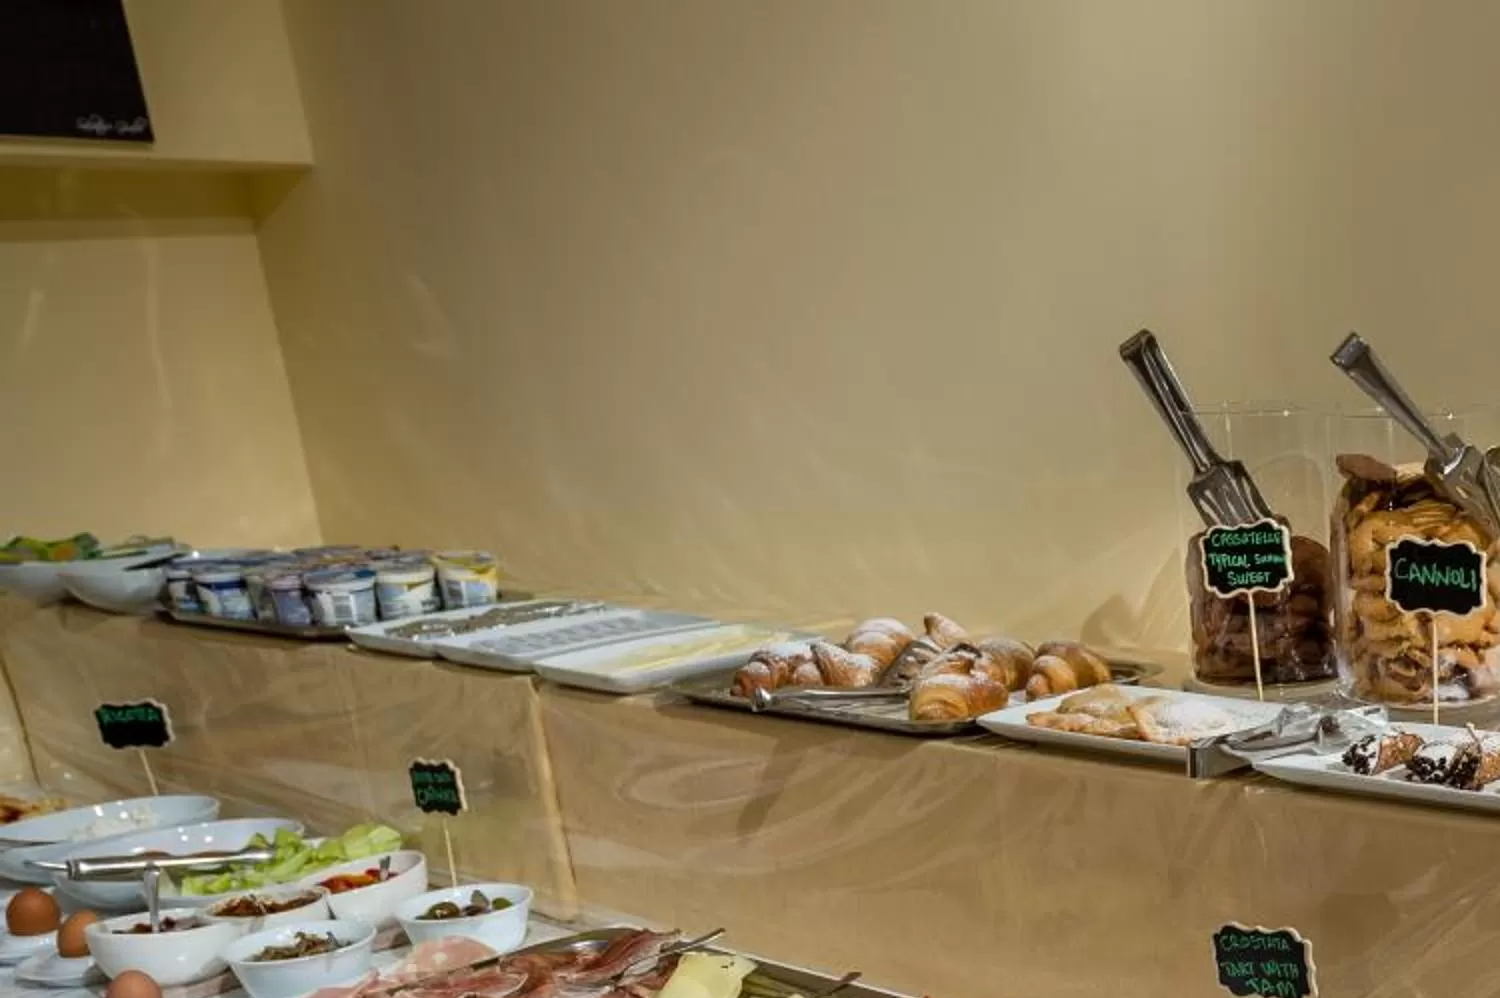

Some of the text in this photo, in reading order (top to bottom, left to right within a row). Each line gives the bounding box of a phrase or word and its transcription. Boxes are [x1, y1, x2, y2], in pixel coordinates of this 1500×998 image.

[1208, 552, 1252, 572] TYPICAL
[1227, 570, 1272, 586] SWEET
[1394, 557, 1478, 592] CANNOLI
